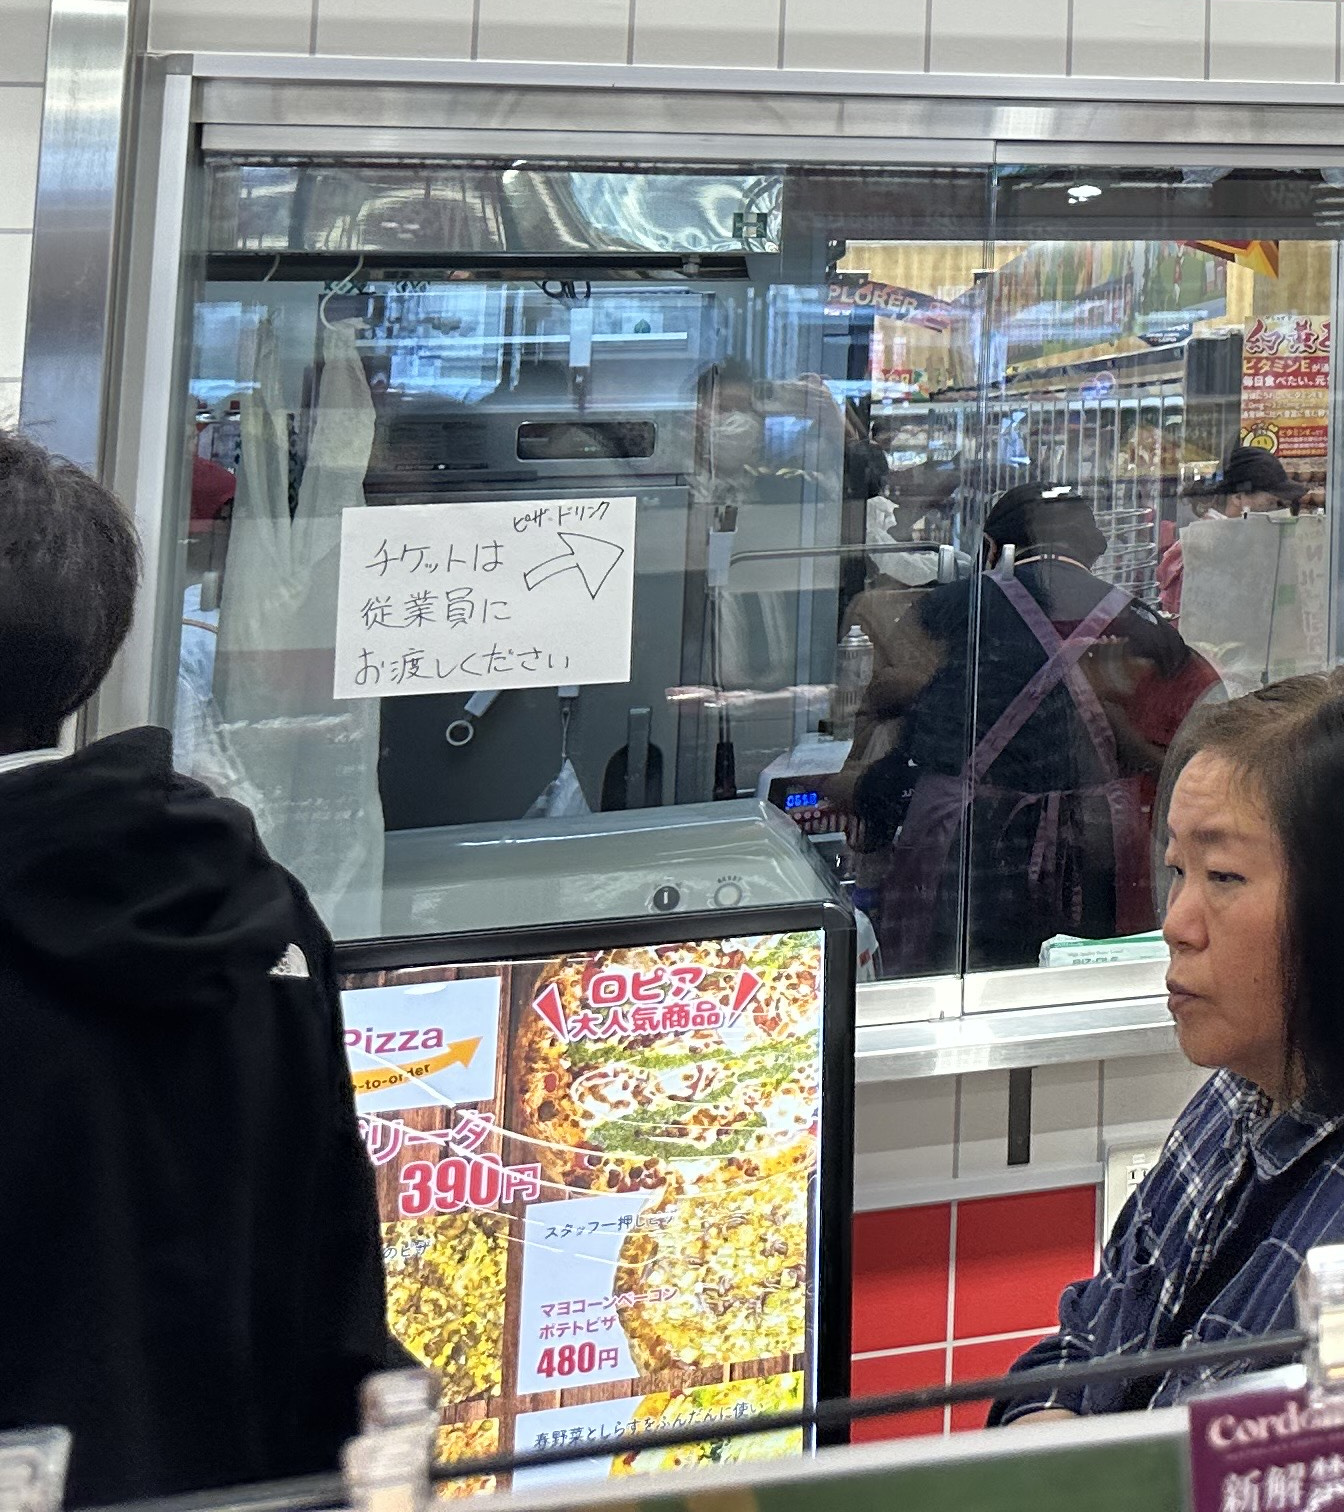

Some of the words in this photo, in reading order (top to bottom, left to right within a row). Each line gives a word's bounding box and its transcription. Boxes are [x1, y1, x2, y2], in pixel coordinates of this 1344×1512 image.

[365, 538, 505, 577] チケットは
[361, 587, 512, 630] 従業員に
[354, 643, 570, 686] お渡しください
[590, 966, 704, 1007] ロピア
[570, 1000, 724, 1040] 大人気商品
[541, 1289, 678, 1318] マヨコーンベーコン
[537, 1342, 619, 1379] 480円
